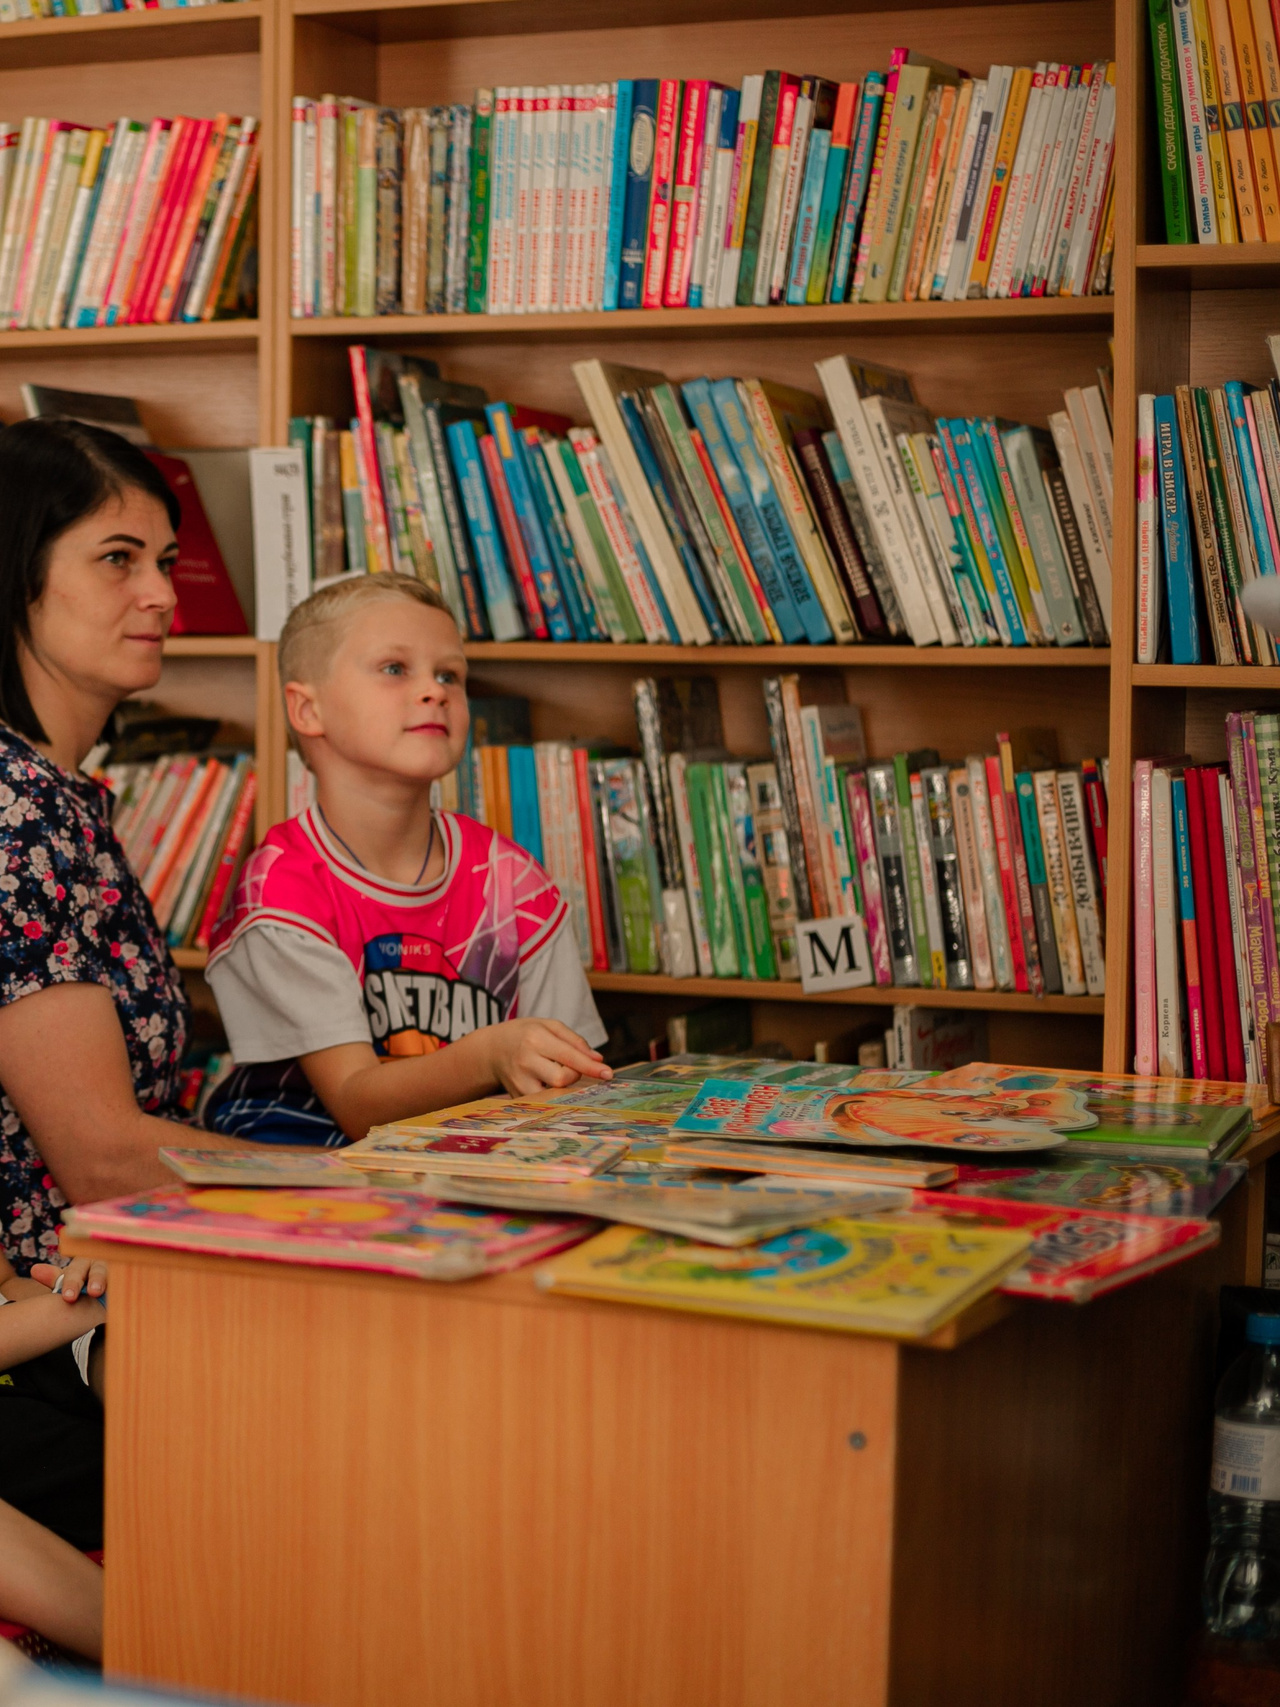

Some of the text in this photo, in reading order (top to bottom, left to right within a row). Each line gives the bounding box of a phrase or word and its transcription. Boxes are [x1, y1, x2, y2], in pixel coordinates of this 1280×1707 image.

[1178, 11, 1191, 45] умниц
[1157, 22, 1172, 80] ДИДАКТИКА
[1184, 56, 1198, 102] умников
[1162, 83, 1176, 130] ДЕДУШКИ
[1189, 104, 1200, 123] для
[1166, 132, 1177, 170] СКАЗКИ
[1191, 125, 1204, 152] игры
[1194, 155, 1208, 195] лучшие
[1063, 175, 1080, 230] АНЕКДОТЫ
[1200, 197, 1212, 234] Самые
[1216, 404, 1225, 421] дому
[1160, 423, 1173, 456] ИГРА
[1220, 431, 1233, 474] мастер-класс
[1162, 459, 1174, 467] В
[1195, 489, 1211, 539] МАКРАМЕ
[1232, 488, 1244, 533] ПИРОГРАФИЯ
[1141, 520, 1150, 554] ДЕВОЧЕК
[1141, 556, 1149, 571] ДЛЯ
[1221, 527, 1239, 588] ДОМАШНИЙ
[1139, 614, 1148, 655] СТИЛЬНЫЕ
[1140, 774, 1150, 828] ПРИНЦЕССЫ
[1060, 784, 1092, 910] ДОБЫВАЙКИ
[1157, 846, 1168, 858] ИЗ
[1223, 826, 1232, 858] ВЫШИВКИ
[1254, 814, 1271, 898] МАСТЕРИЛКА
[1157, 864, 1169, 909] ПОДЕЛКИ
[1228, 897, 1239, 934] ИСКУССТВО
[803, 923, 863, 979] М
[1161, 998, 1170, 1038] Корнева
[1194, 1033, 1202, 1060] НАТАЛЬЯ
